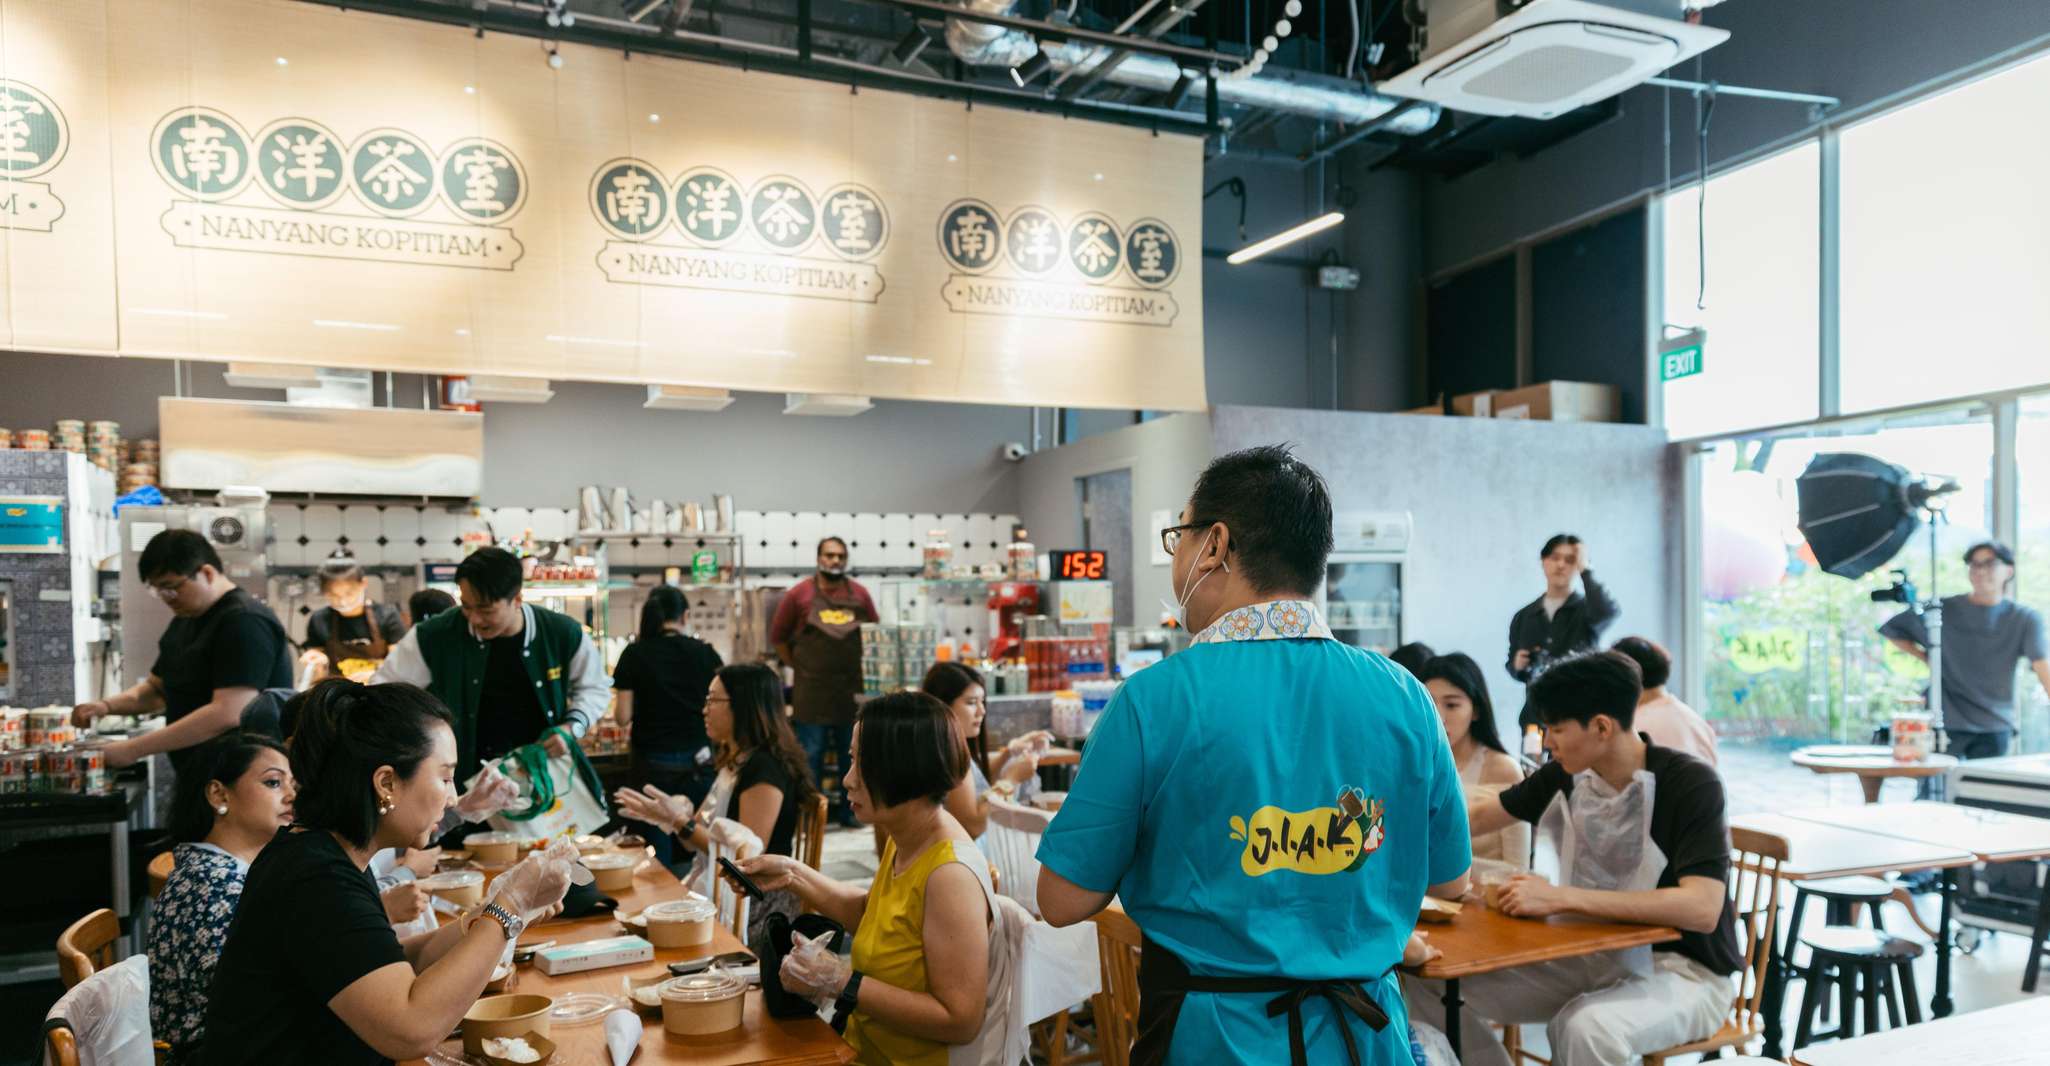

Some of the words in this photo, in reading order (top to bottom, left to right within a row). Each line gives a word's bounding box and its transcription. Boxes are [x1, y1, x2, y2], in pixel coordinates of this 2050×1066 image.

[171, 119, 509, 211] 南洋茶室
[606, 169, 877, 249] 南洋茶室
[201, 214, 349, 246] NANYANG
[356, 227, 489, 257] KOPITIAM
[951, 210, 1169, 277] 南洋茶室
[628, 253, 747, 280] NANYANG
[753, 263, 858, 291] KOPITIAM
[1070, 294, 1156, 316] KOPITIAM
[1664, 350, 1697, 378] EXIT
[1063, 552, 1104, 578] 152
